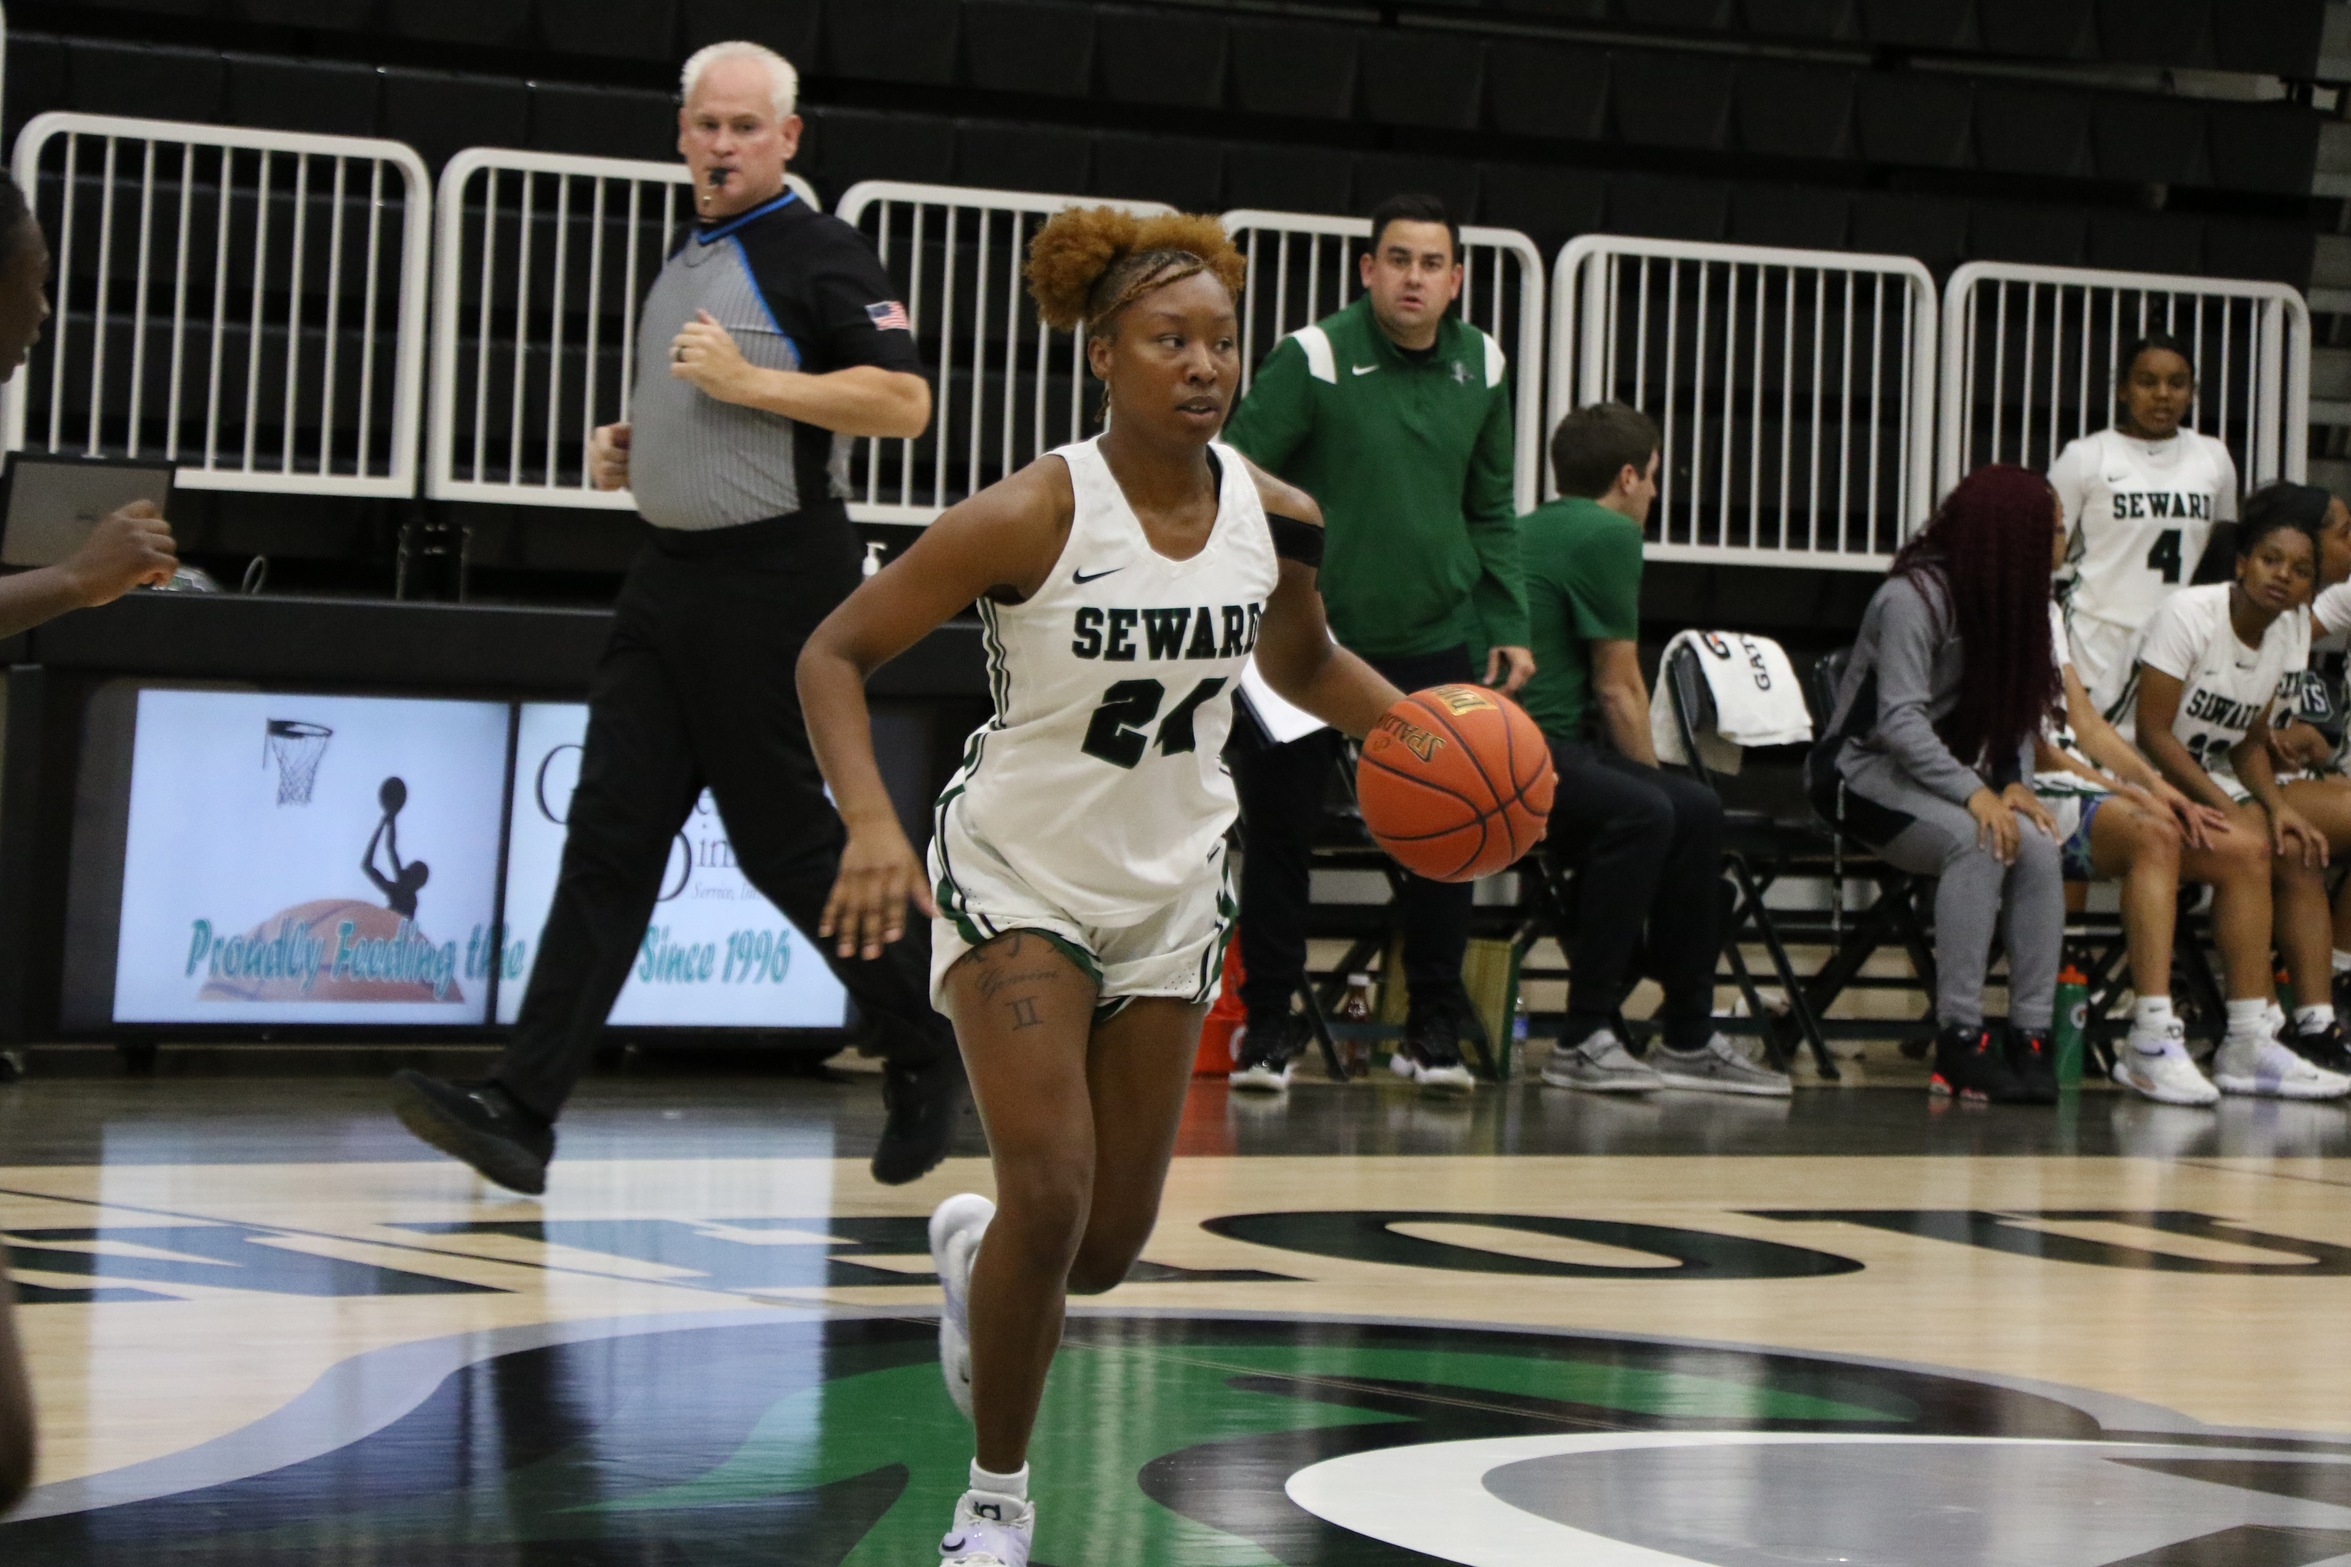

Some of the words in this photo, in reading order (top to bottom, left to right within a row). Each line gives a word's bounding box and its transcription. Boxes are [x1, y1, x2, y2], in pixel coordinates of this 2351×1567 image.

[2147, 528, 2182, 584] 4
[184, 916, 323, 994] Proudly
[331, 919, 458, 999] Feeding
[638, 924, 716, 984] Since
[721, 928, 791, 985] 1996
